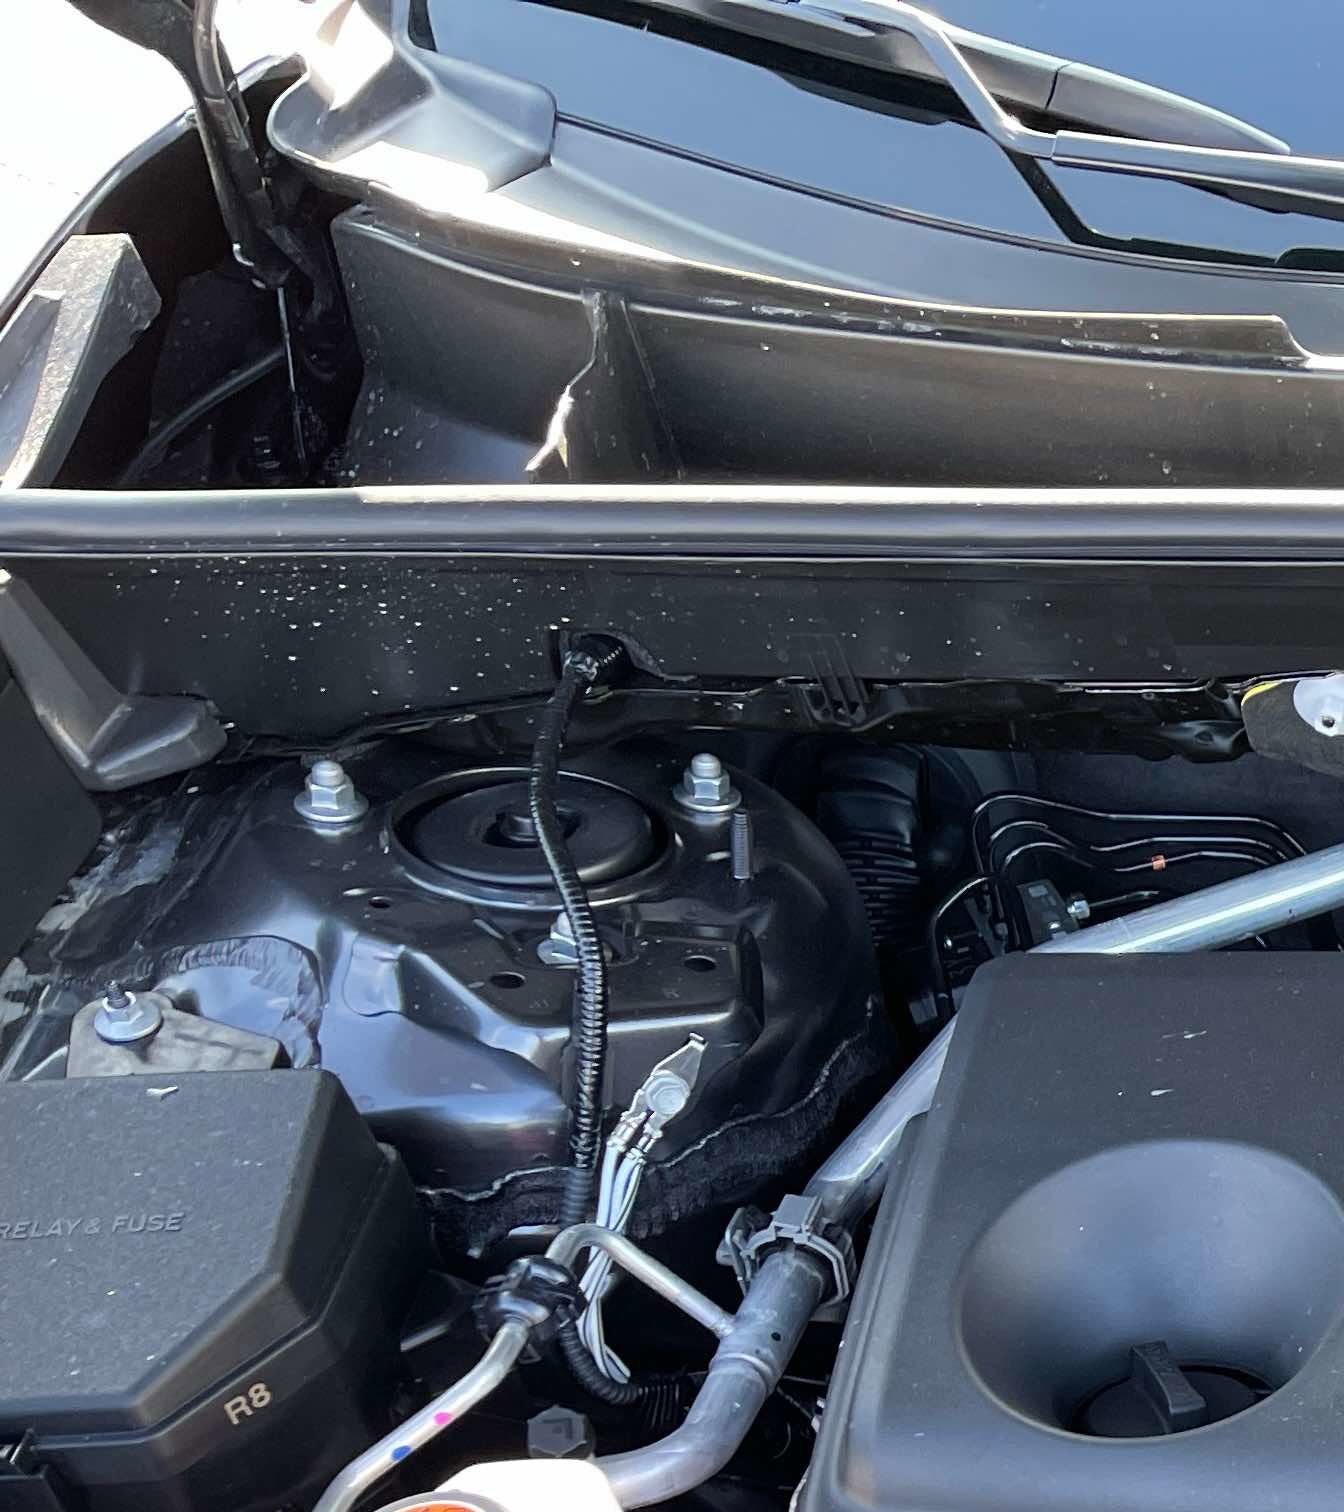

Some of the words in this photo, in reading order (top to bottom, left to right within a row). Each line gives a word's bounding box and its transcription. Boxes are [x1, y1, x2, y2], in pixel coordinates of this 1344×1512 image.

[85, 1217, 100, 1234] &
[112, 1212, 185, 1232] FUSE
[224, 1382, 271, 1425] R8
